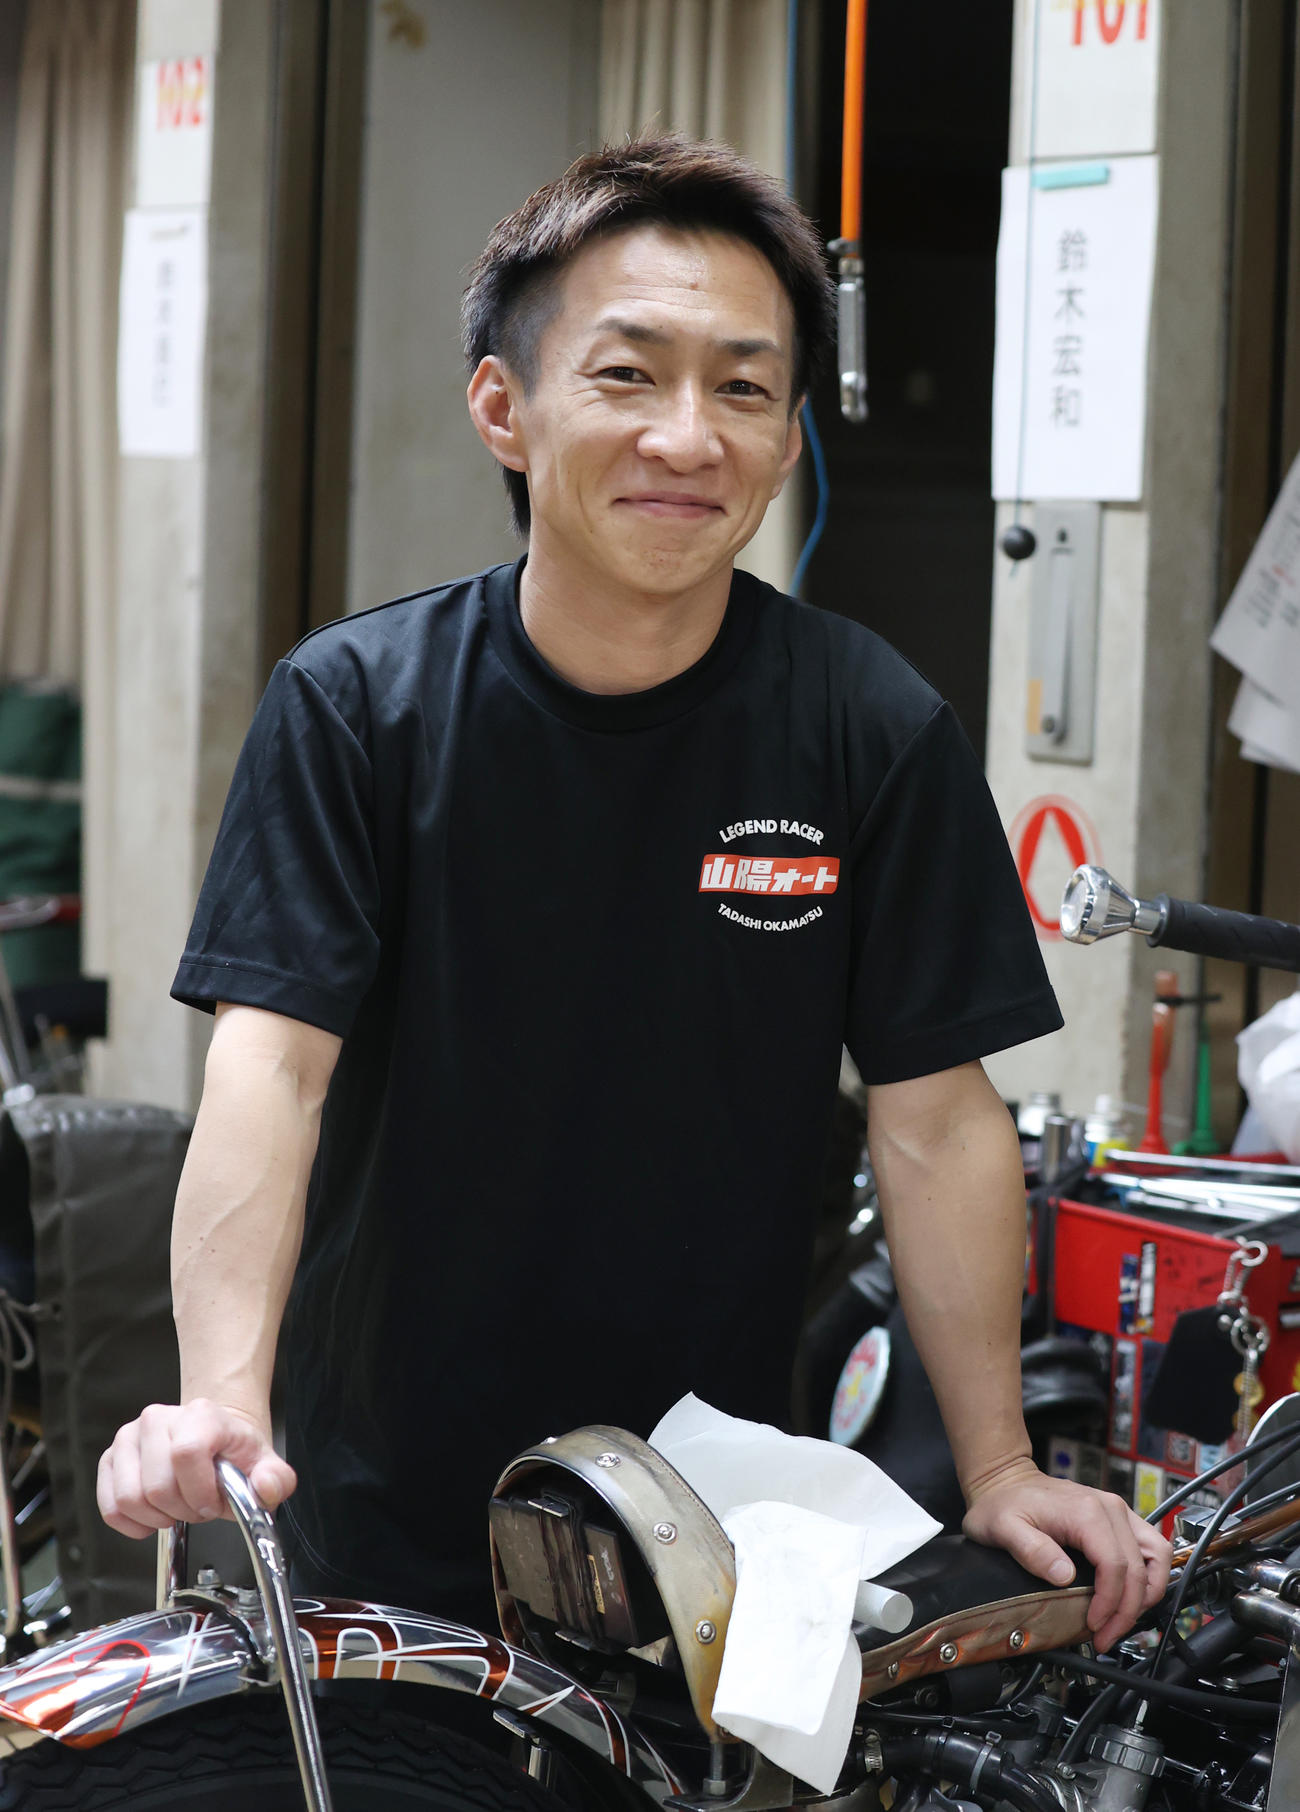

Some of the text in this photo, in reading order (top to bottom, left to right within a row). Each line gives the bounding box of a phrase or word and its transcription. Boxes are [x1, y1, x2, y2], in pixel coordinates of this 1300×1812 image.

[718, 819, 825, 846] LEGEND RACER
[700, 856, 838, 893] 山陽オート
[717, 902, 824, 932] TADASHI OKAMATSU
